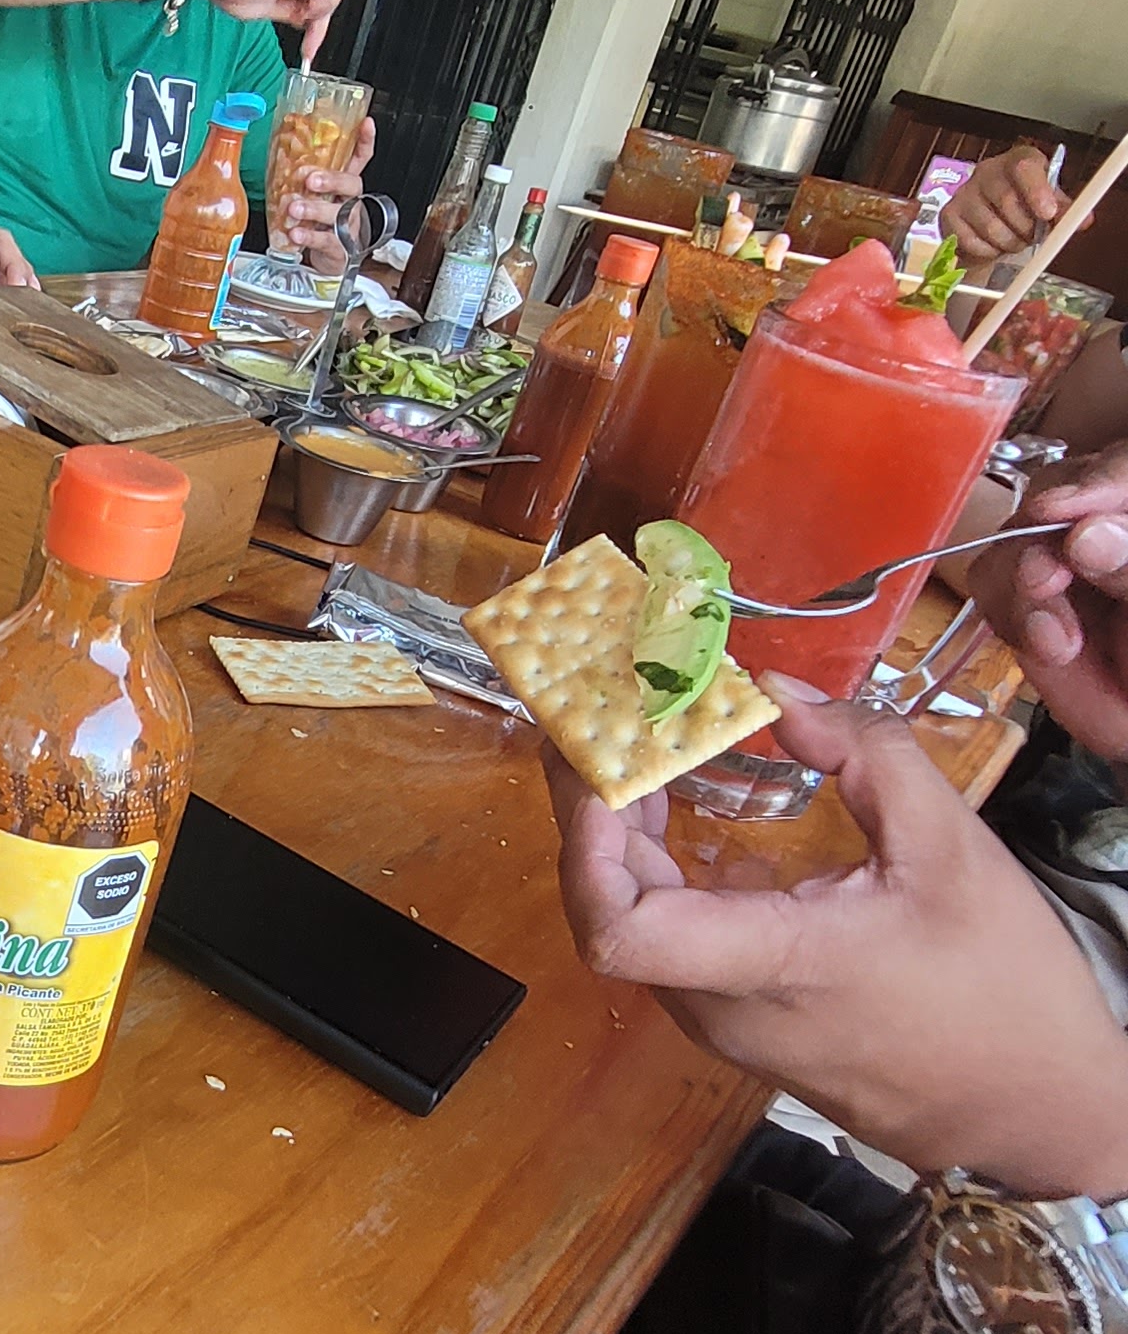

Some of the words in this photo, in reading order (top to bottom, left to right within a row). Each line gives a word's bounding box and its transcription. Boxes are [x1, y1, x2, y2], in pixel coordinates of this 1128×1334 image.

[110, 70, 197, 187] N
[94, 870, 138, 887] EXCESO
[95, 885, 130, 900] SODIO
[7, 984, 62, 1000] Picante
